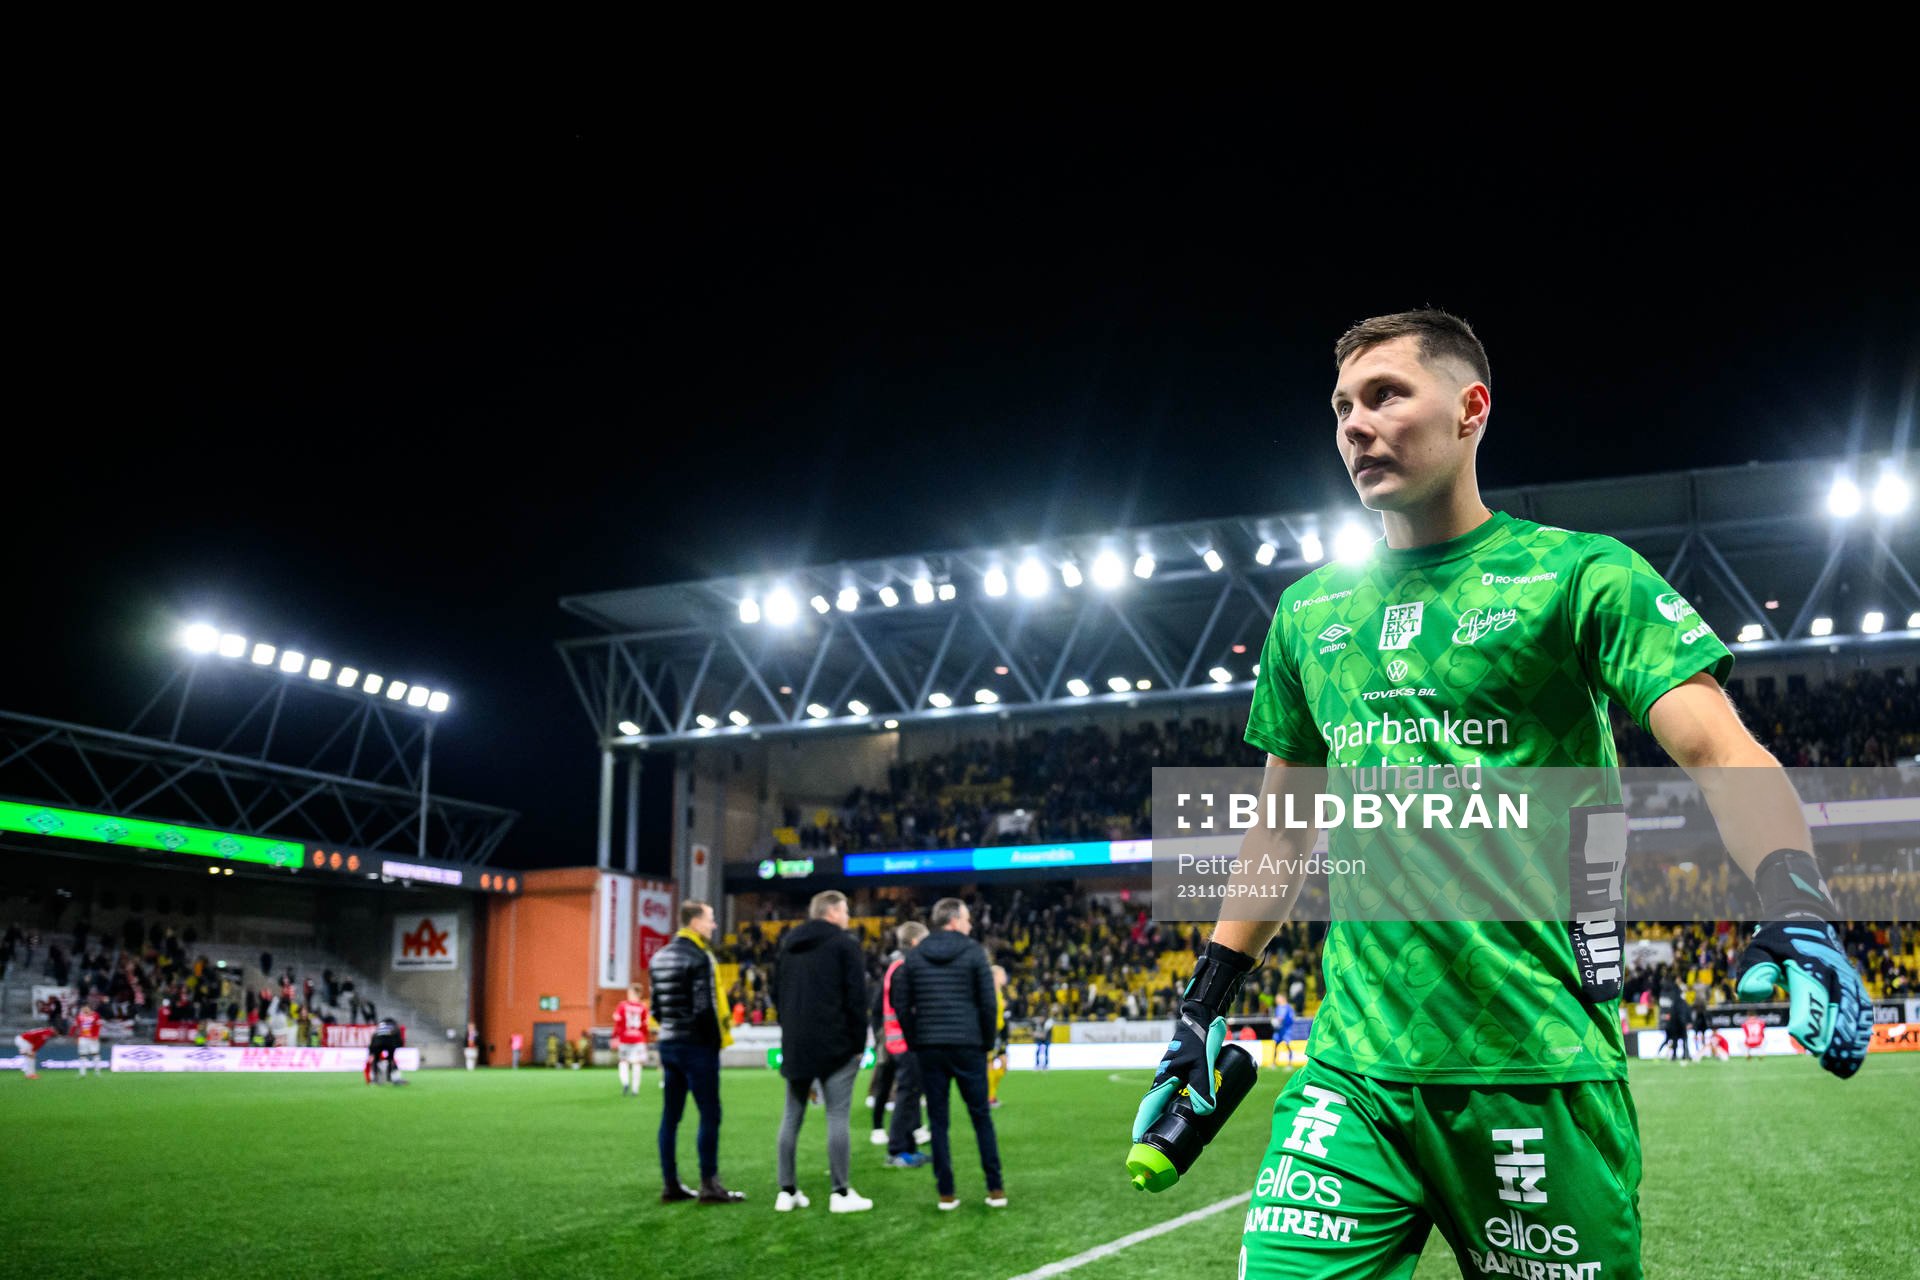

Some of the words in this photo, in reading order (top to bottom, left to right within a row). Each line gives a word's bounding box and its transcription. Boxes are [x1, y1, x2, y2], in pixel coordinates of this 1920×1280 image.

[1495, 571, 1558, 584] RO-GRUPPEN
[1301, 589, 1353, 607] RO-GRUPPEN
[1388, 605, 1417, 621] EFF
[1386, 619, 1418, 634] EKT
[1319, 642, 1347, 655] umbro
[1383, 633, 1402, 647] IV
[1361, 688, 1416, 700] TOVEKS
[1417, 688, 1437, 696] BIL
[1322, 710, 1508, 759] Sparbanken
[1341, 756, 1483, 792] juhärad
[1572, 926, 1595, 986] interiör
[1256, 1155, 1343, 1207] ellos
[1243, 1206, 1359, 1243] AMIRENT
[1484, 1209, 1580, 1256] ellos
